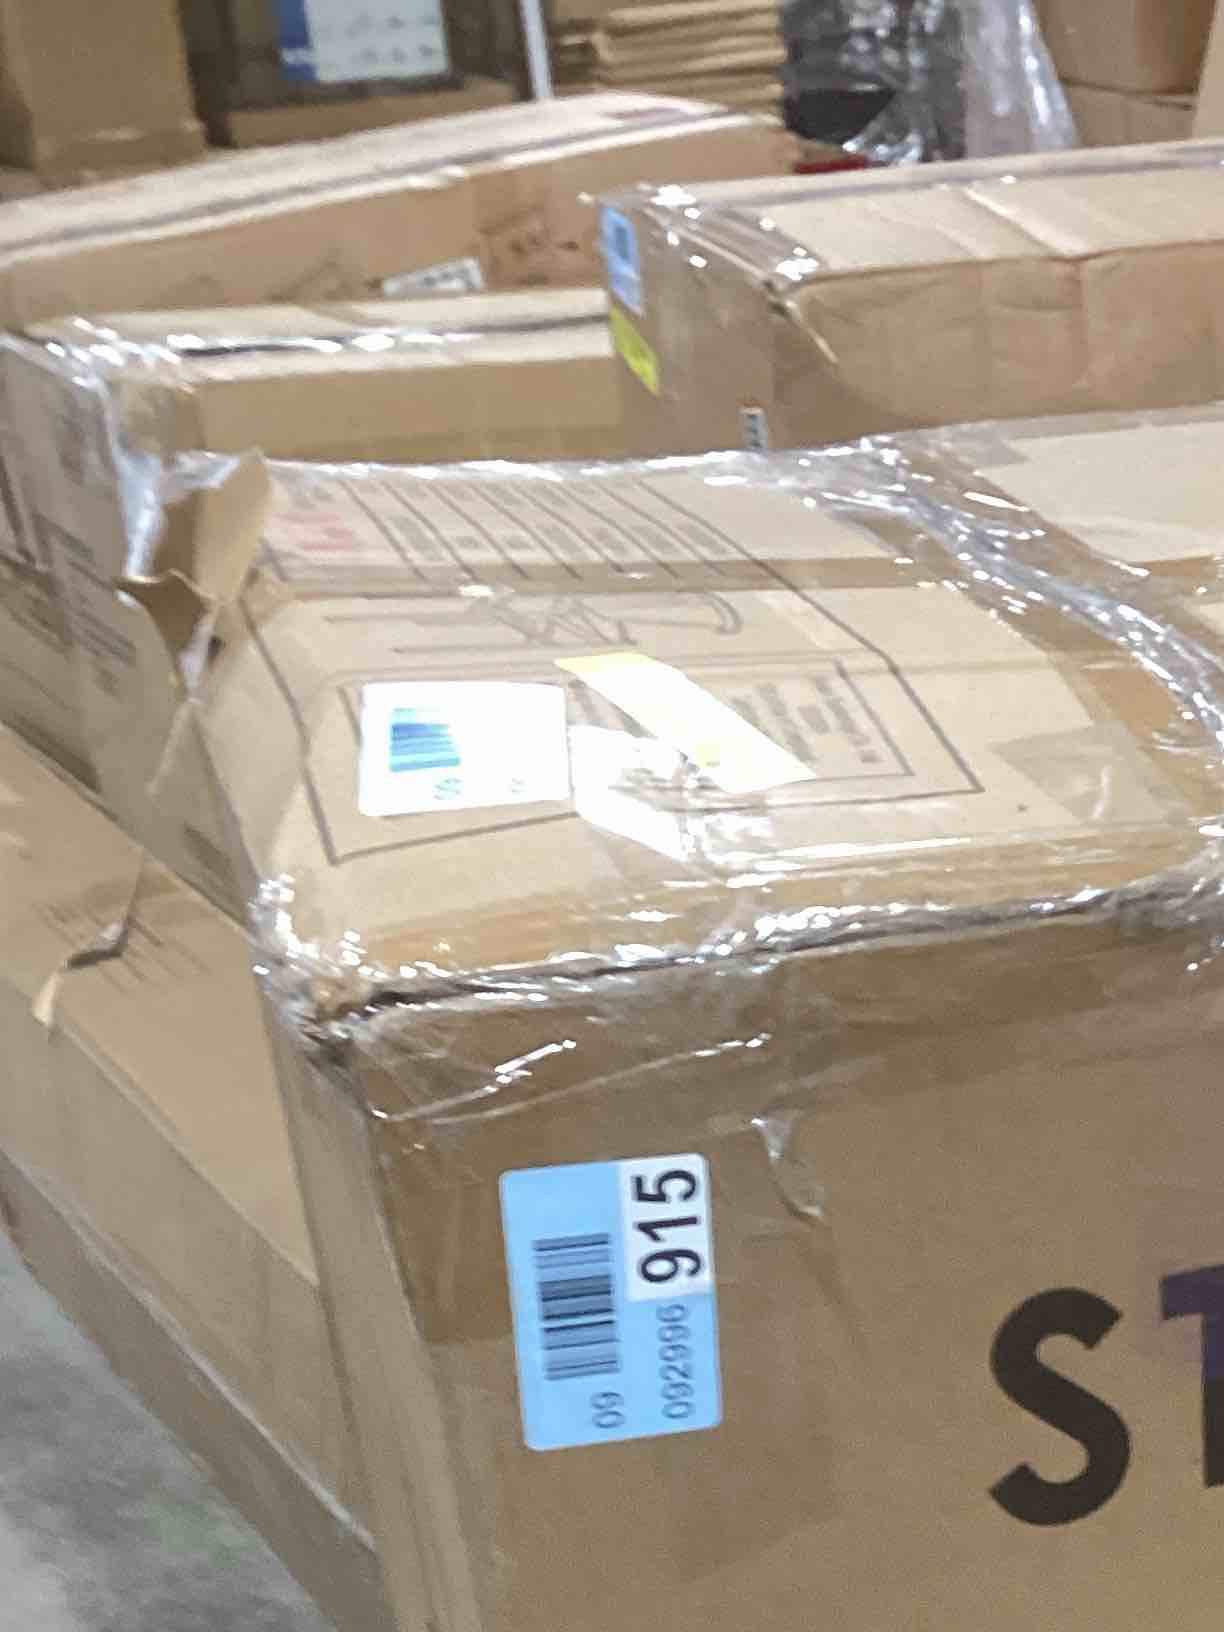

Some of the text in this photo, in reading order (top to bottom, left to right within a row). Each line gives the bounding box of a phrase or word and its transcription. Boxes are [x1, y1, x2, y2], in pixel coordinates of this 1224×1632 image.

[631, 1168, 702, 1284] 915
[590, 1391, 626, 1430] 09
[656, 1303, 695, 1420] 092996
